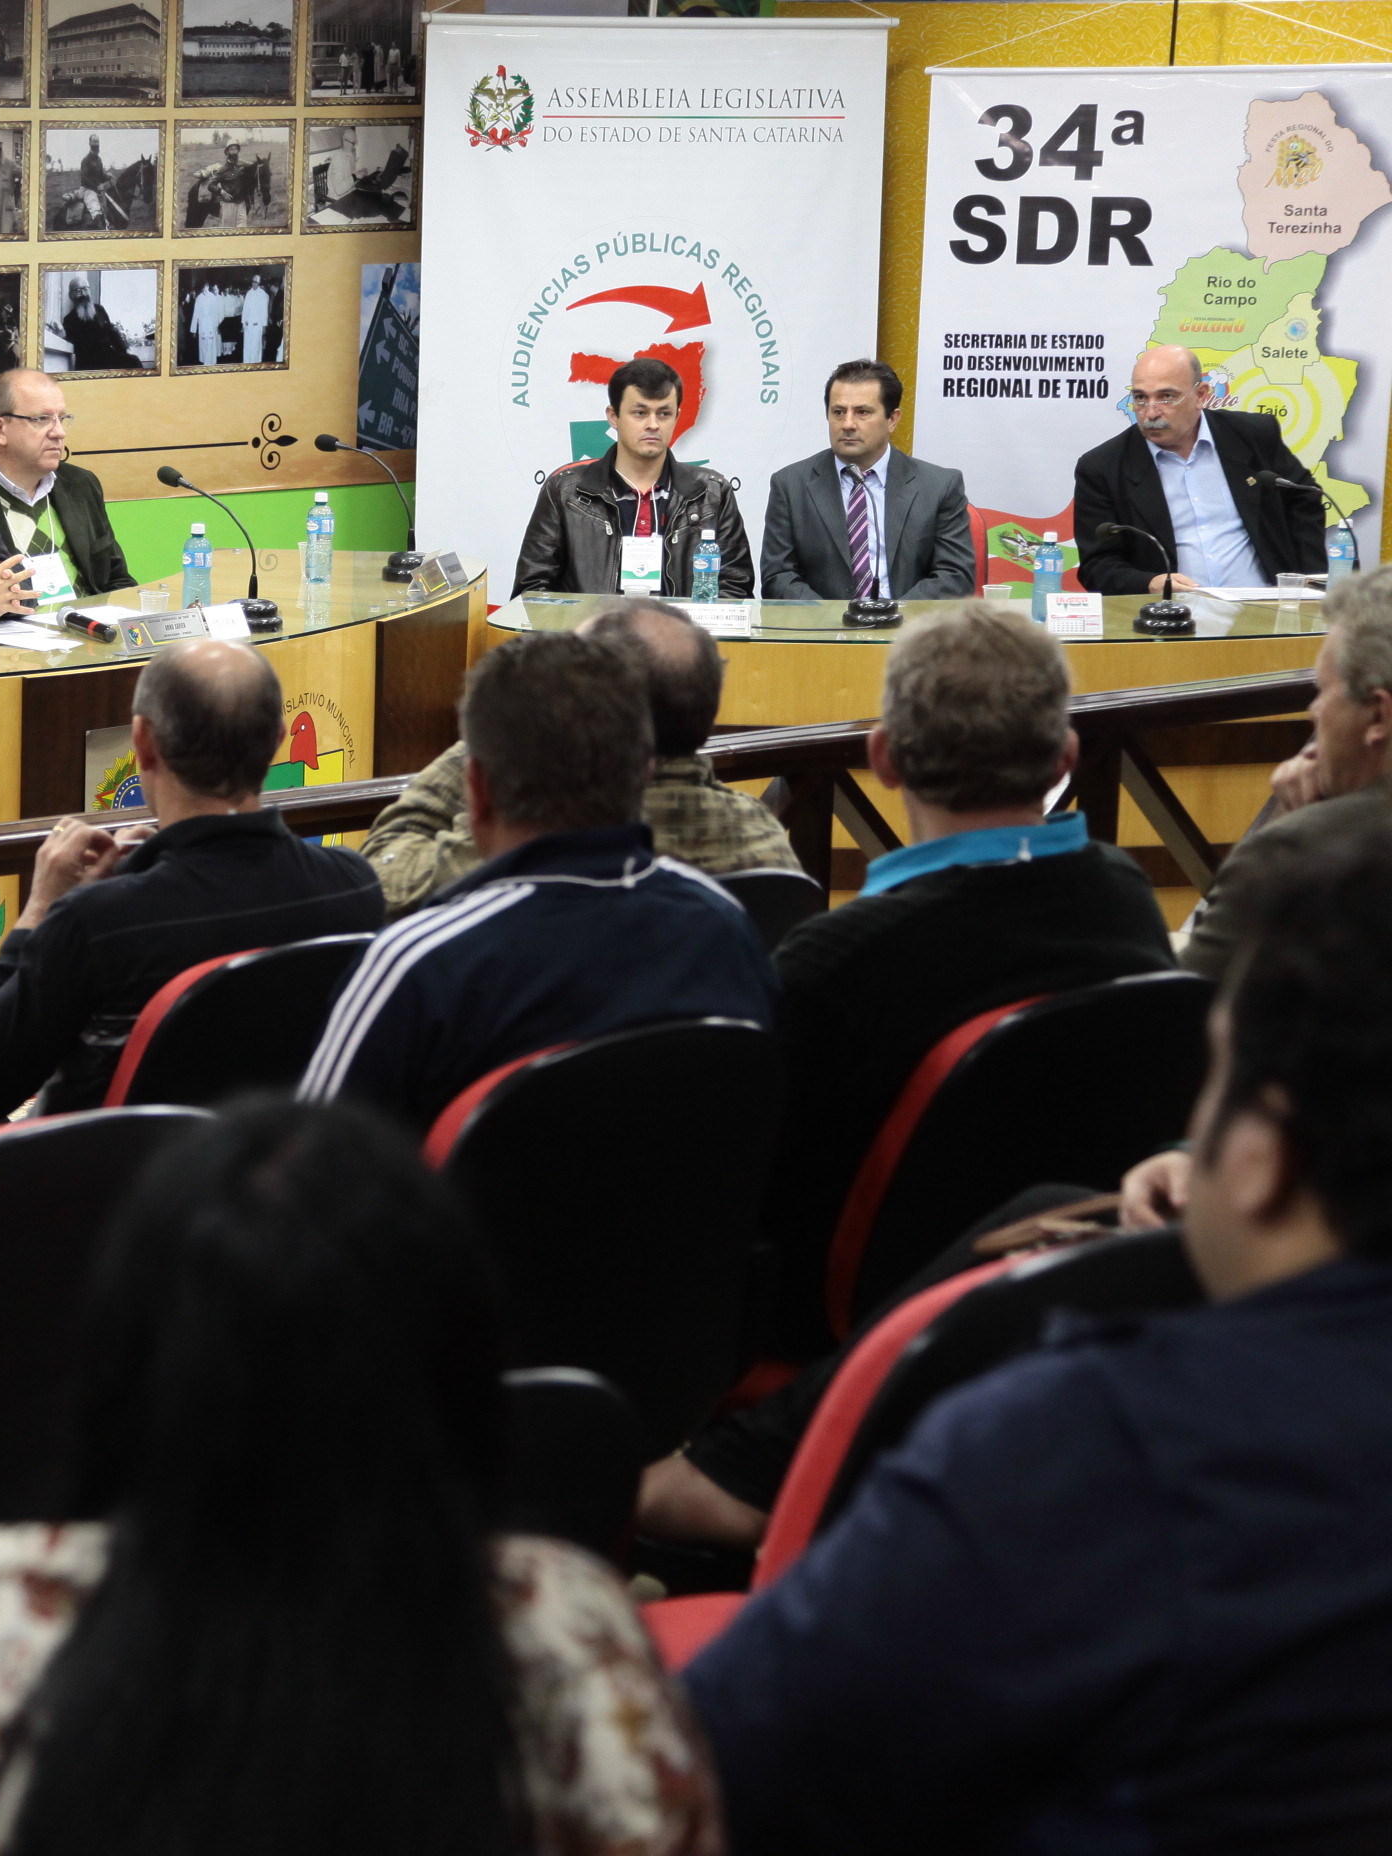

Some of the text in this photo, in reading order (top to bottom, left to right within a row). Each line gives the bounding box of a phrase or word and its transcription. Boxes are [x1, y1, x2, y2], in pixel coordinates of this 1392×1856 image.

[546, 87, 846, 109] ASSEMBLEIA LEGISLATIVA
[542, 125, 844, 143] DO ESTADO DE SANTA CATARINA
[1265, 123, 1334, 153] FESTA REGIONAL DO
[1264, 161, 1326, 189] Mel
[1283, 204, 1328, 217] Santa
[949, 193, 1154, 267] SDR
[1267, 221, 1342, 234] Terezinha
[1206, 275, 1257, 288] Rio do
[1203, 293, 1257, 308] Campo
[511, 231, 781, 409] AUDIÊNCIAS PÚBLICAS REGIONAIS
[944, 333, 1105, 350] SECRETARIA DE ESTADO
[1261, 346, 1309, 359] Salete
[943, 355, 1105, 372] DO DESENVOLVIMENTO
[943, 375, 1109, 399] REGIONAL DE TAIÓ
[1256, 404, 1288, 417] Taió
[282, 692, 356, 769] ISLATIVO MUNICIPAL
